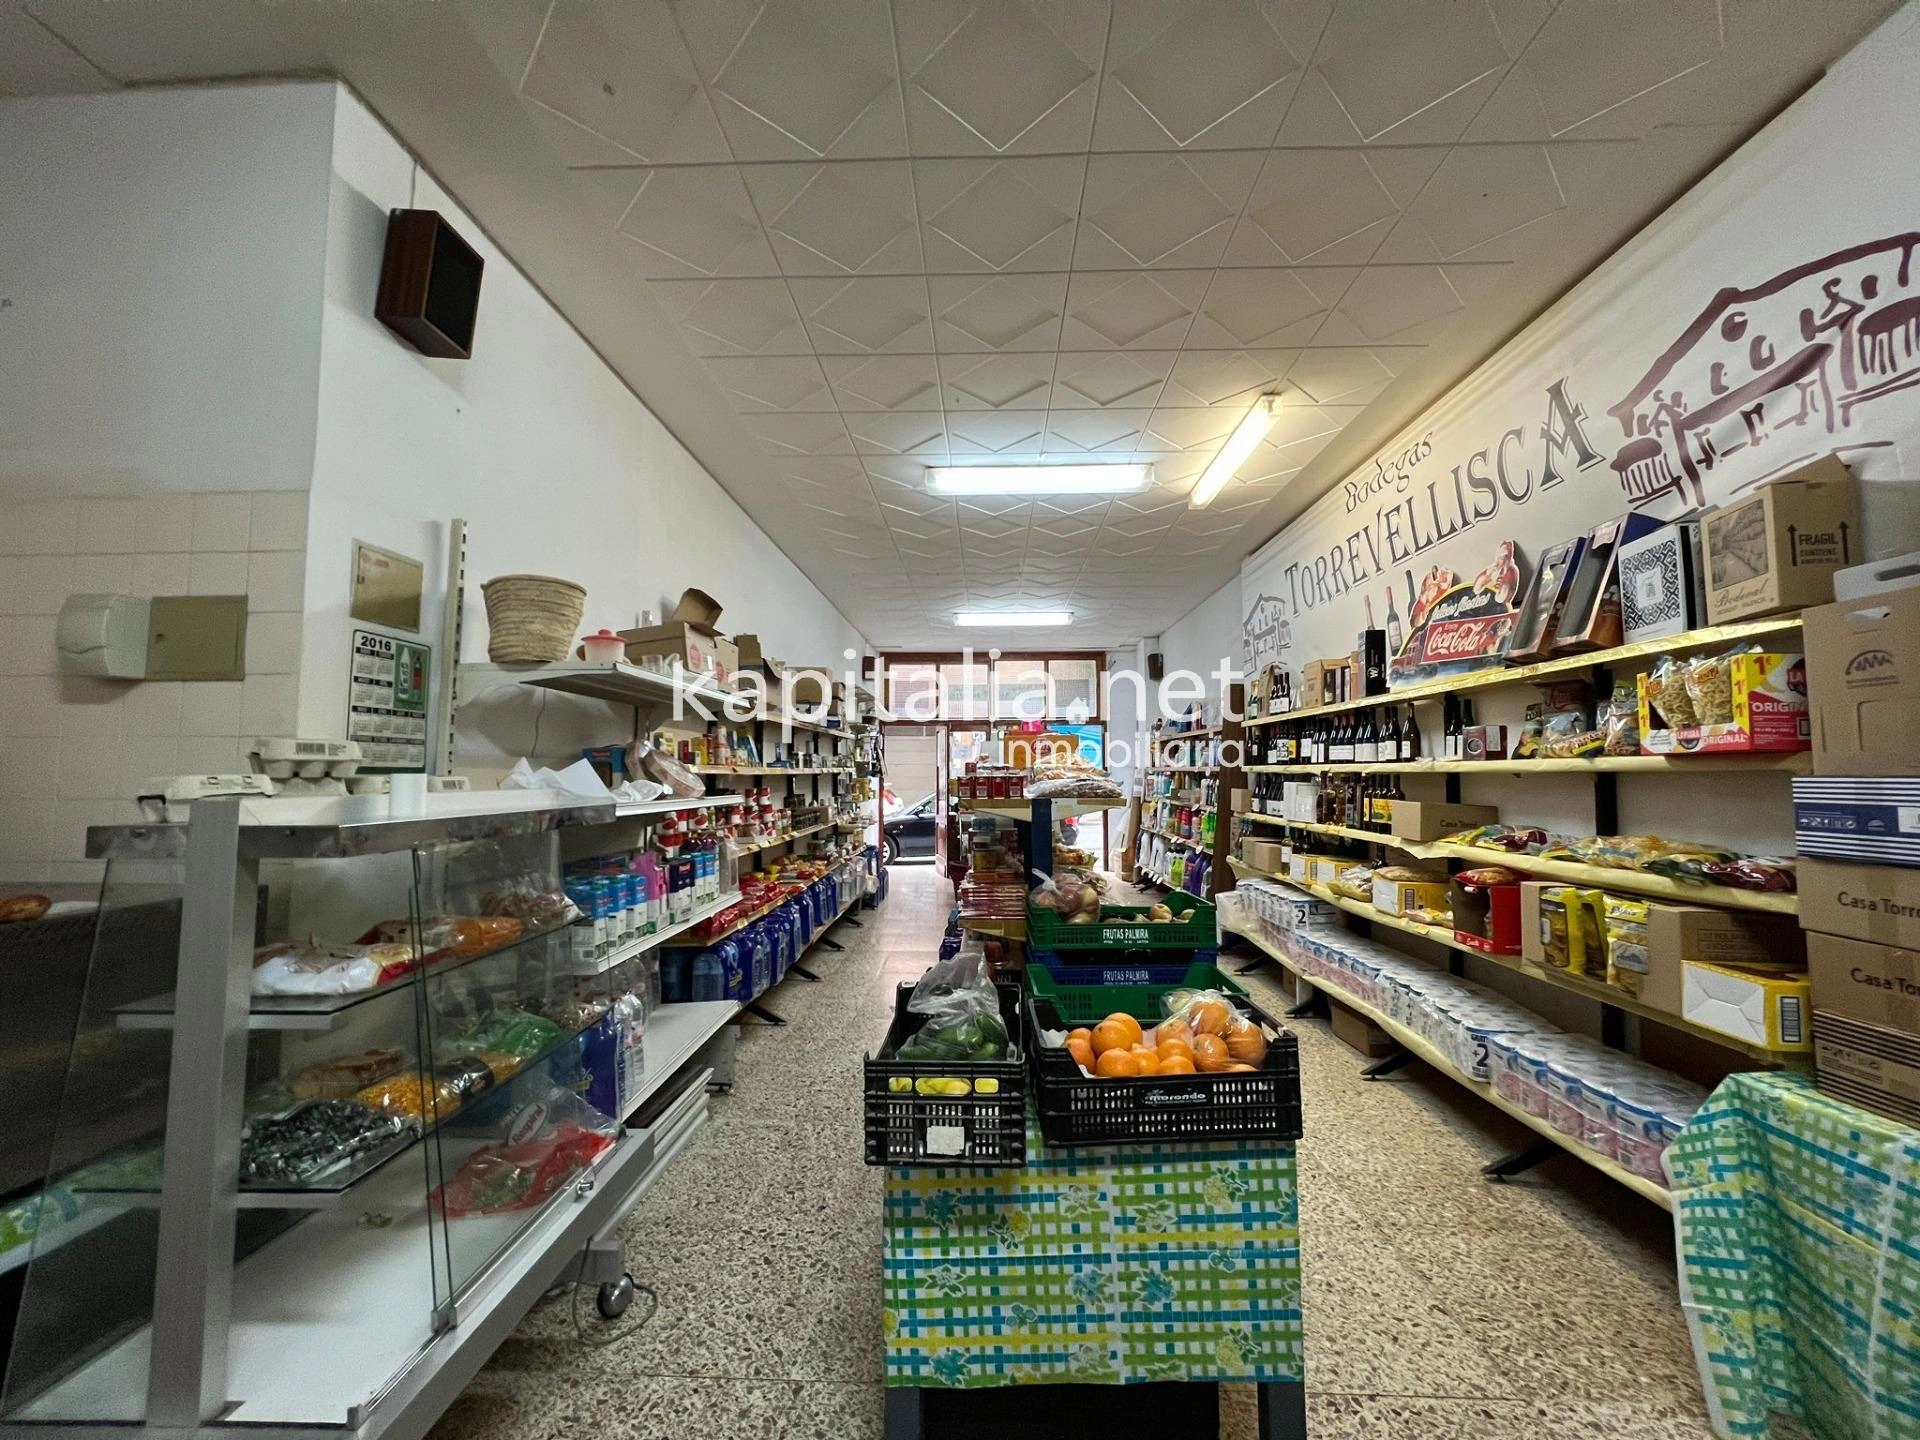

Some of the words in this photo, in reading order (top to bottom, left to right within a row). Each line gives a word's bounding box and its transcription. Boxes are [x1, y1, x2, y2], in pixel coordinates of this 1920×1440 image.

[1344, 432, 1432, 513] Bodegas
[1799, 533, 1839, 546] FRAGIL
[361, 635, 392, 651] 2016
[1702, 733, 1747, 745] ORIGINAL
[1838, 892, 1877, 911] Casa
[1103, 929, 1124, 940] FRUTAS
[1125, 928, 1149, 940] PALMIRA
[1104, 971, 1124, 981] FRUTAS
[1125, 970, 1149, 981] PALMIRA
[1850, 968, 1893, 990] Casa
